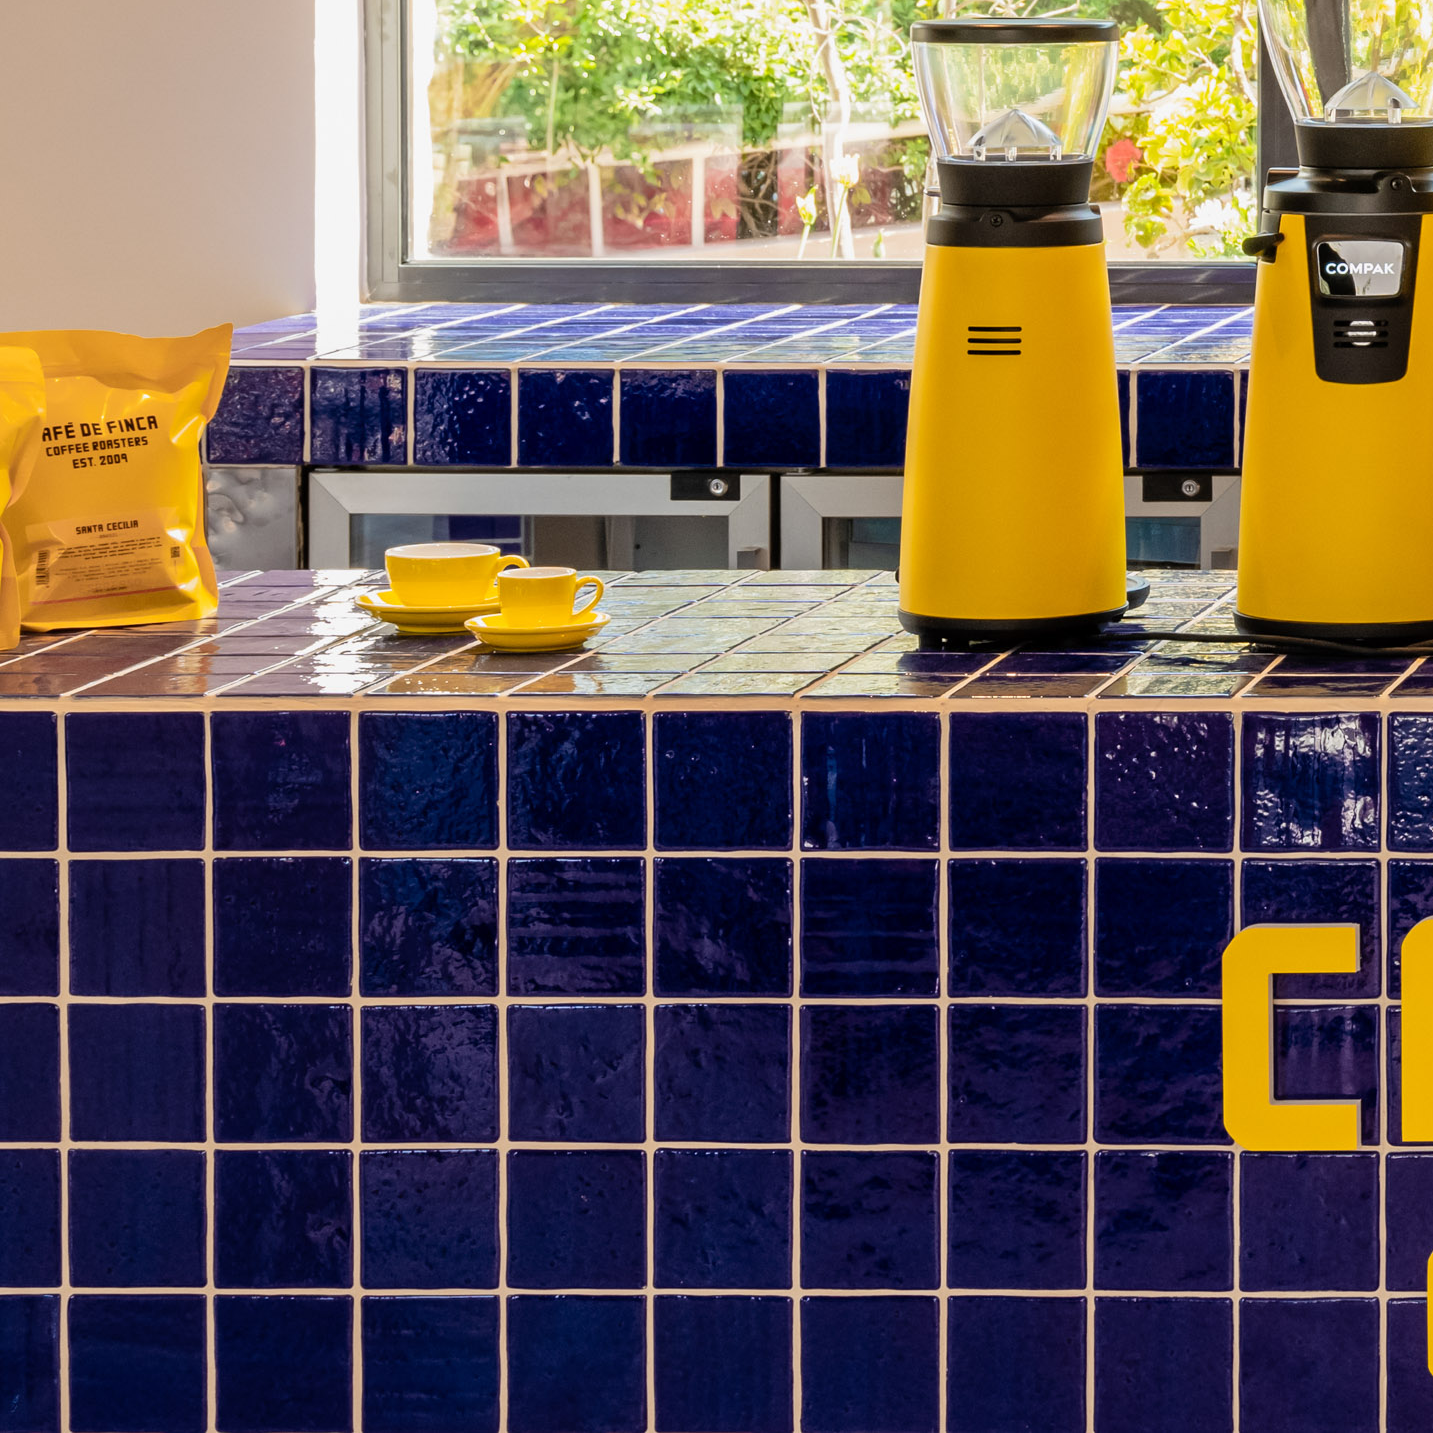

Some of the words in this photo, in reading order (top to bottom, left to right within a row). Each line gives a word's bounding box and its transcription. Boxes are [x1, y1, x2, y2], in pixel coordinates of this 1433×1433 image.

[1325, 262, 1395, 275] COMPAK
[42, 422, 76, 442] AFÉ
[80, 423, 103, 437] DE
[106, 415, 159, 434] FINCA
[46, 442, 90, 457] COFFEE
[92, 436, 149, 451] ROASTERS
[72, 457, 97, 469] EST.
[99, 453, 128, 466] 2009
[75, 524, 104, 535] SANTA
[106, 519, 139, 531] CECILIA
